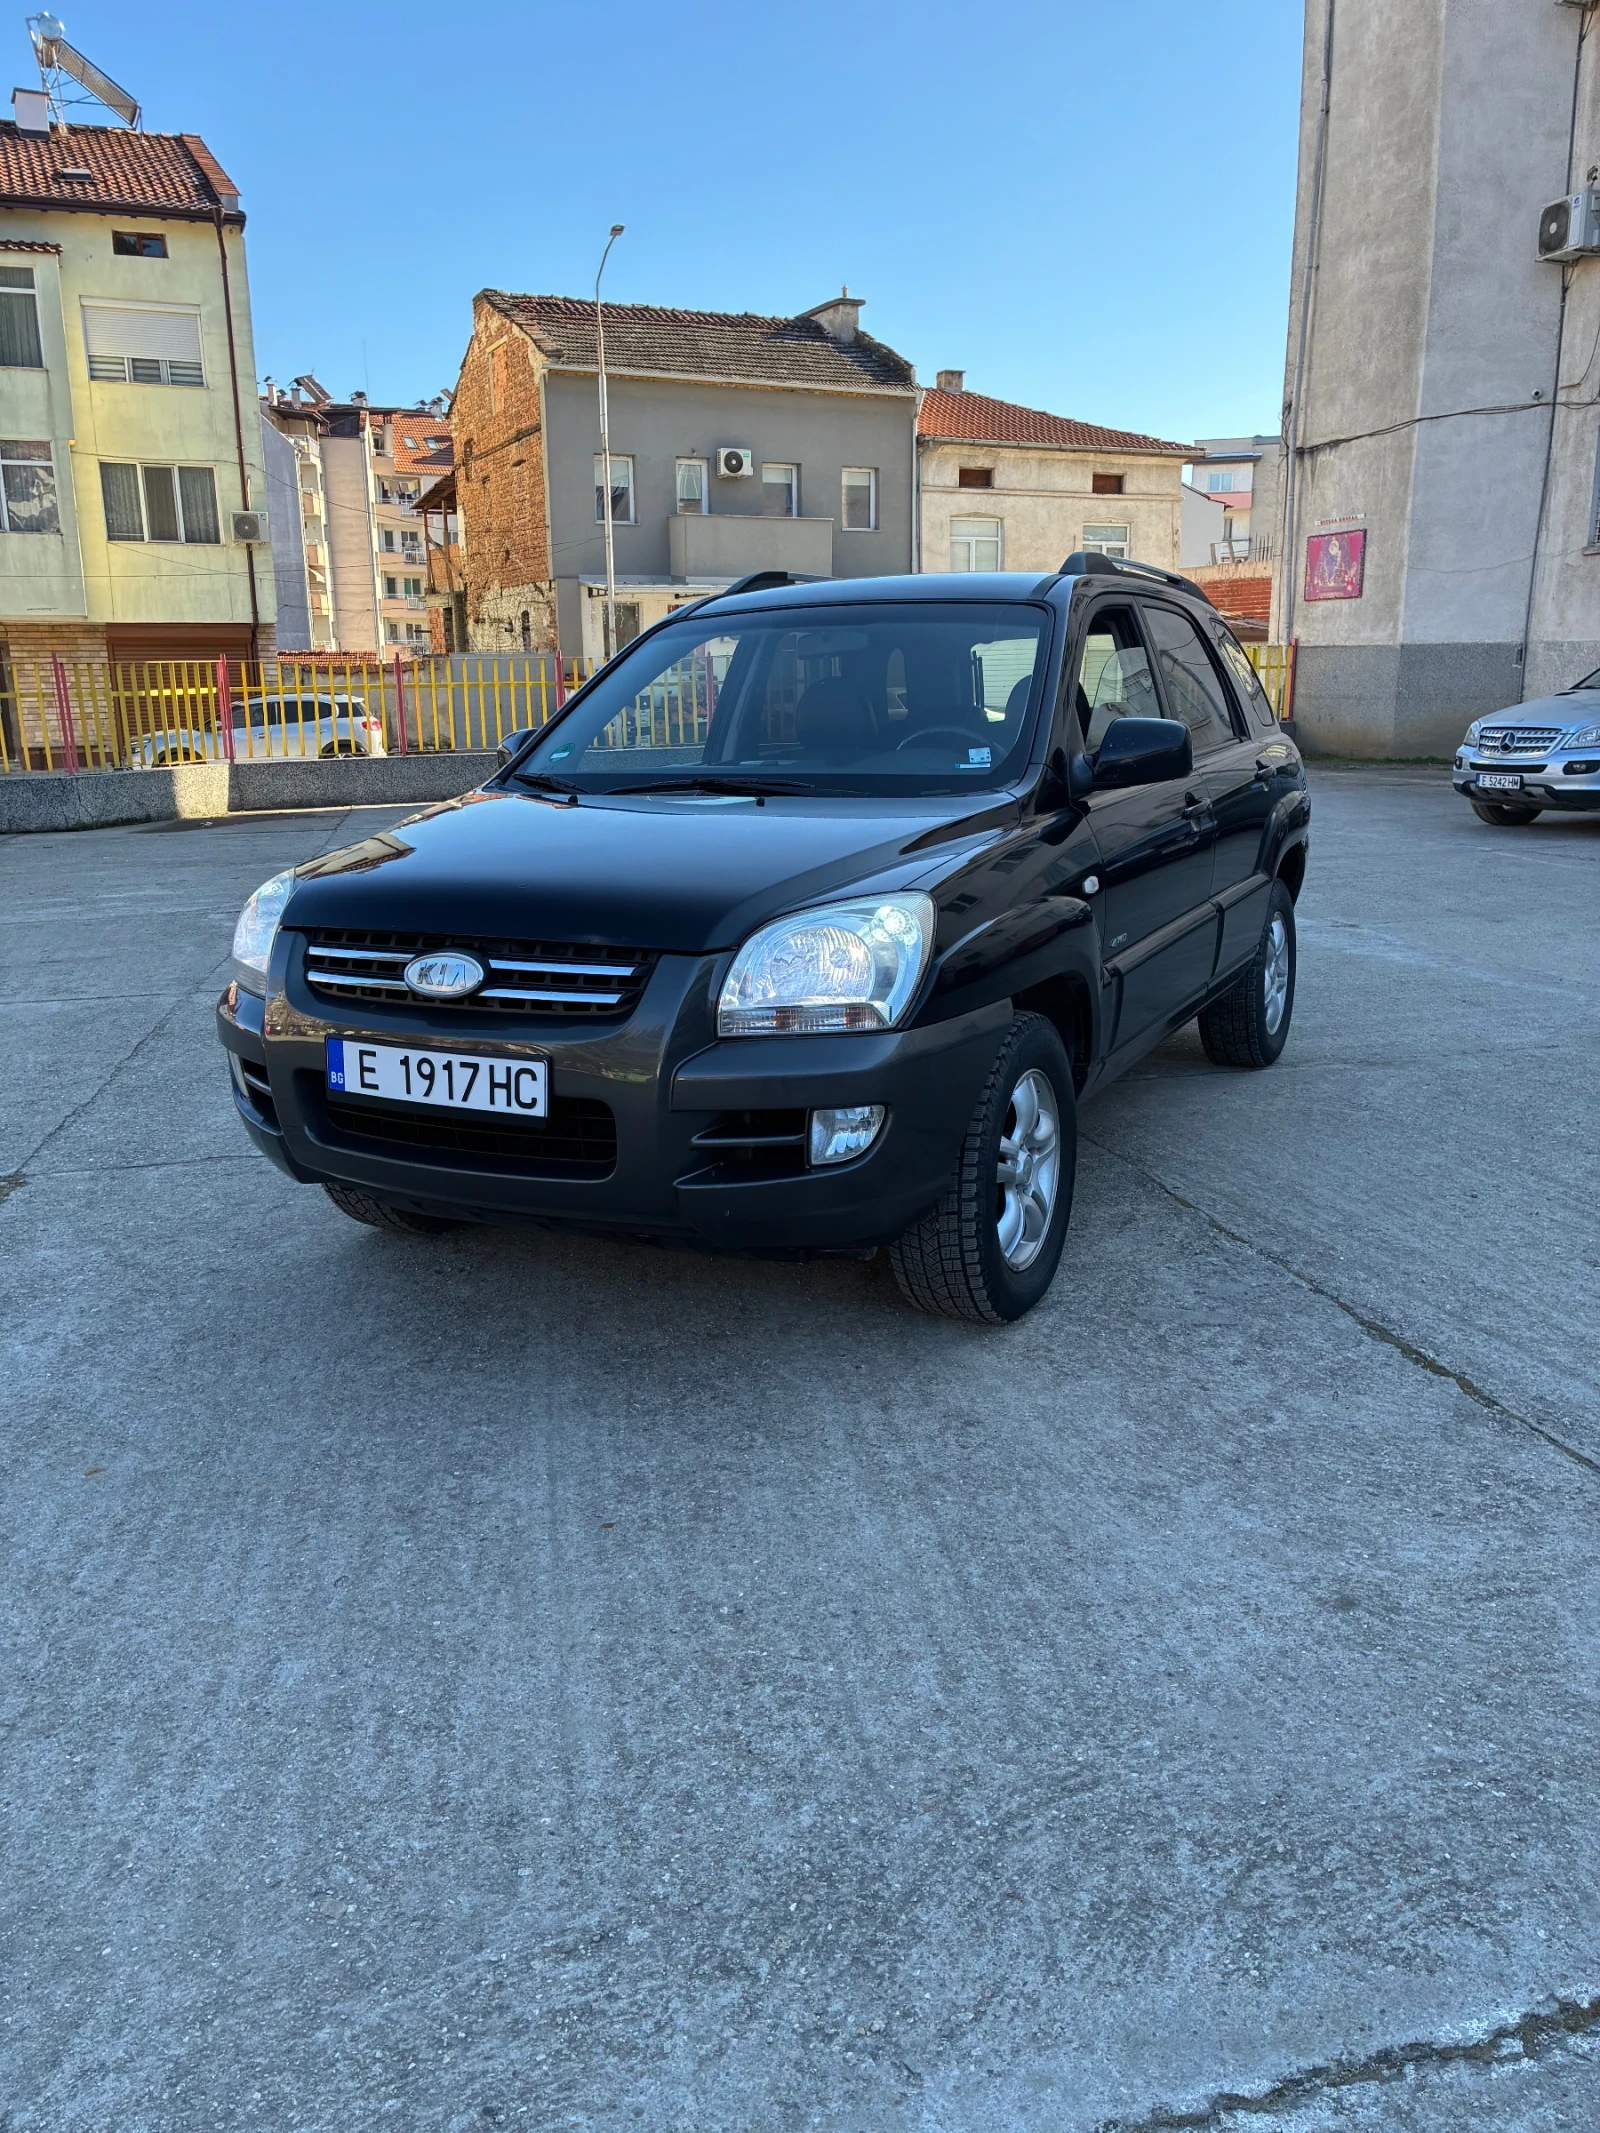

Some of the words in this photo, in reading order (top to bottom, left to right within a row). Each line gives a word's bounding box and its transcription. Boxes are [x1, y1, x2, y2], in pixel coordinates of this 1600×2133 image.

[1481, 776, 1487, 786] E
[416, 961, 466, 988] KIA
[331, 1071, 344, 1085] BG
[358, 1049, 380, 1091] E
